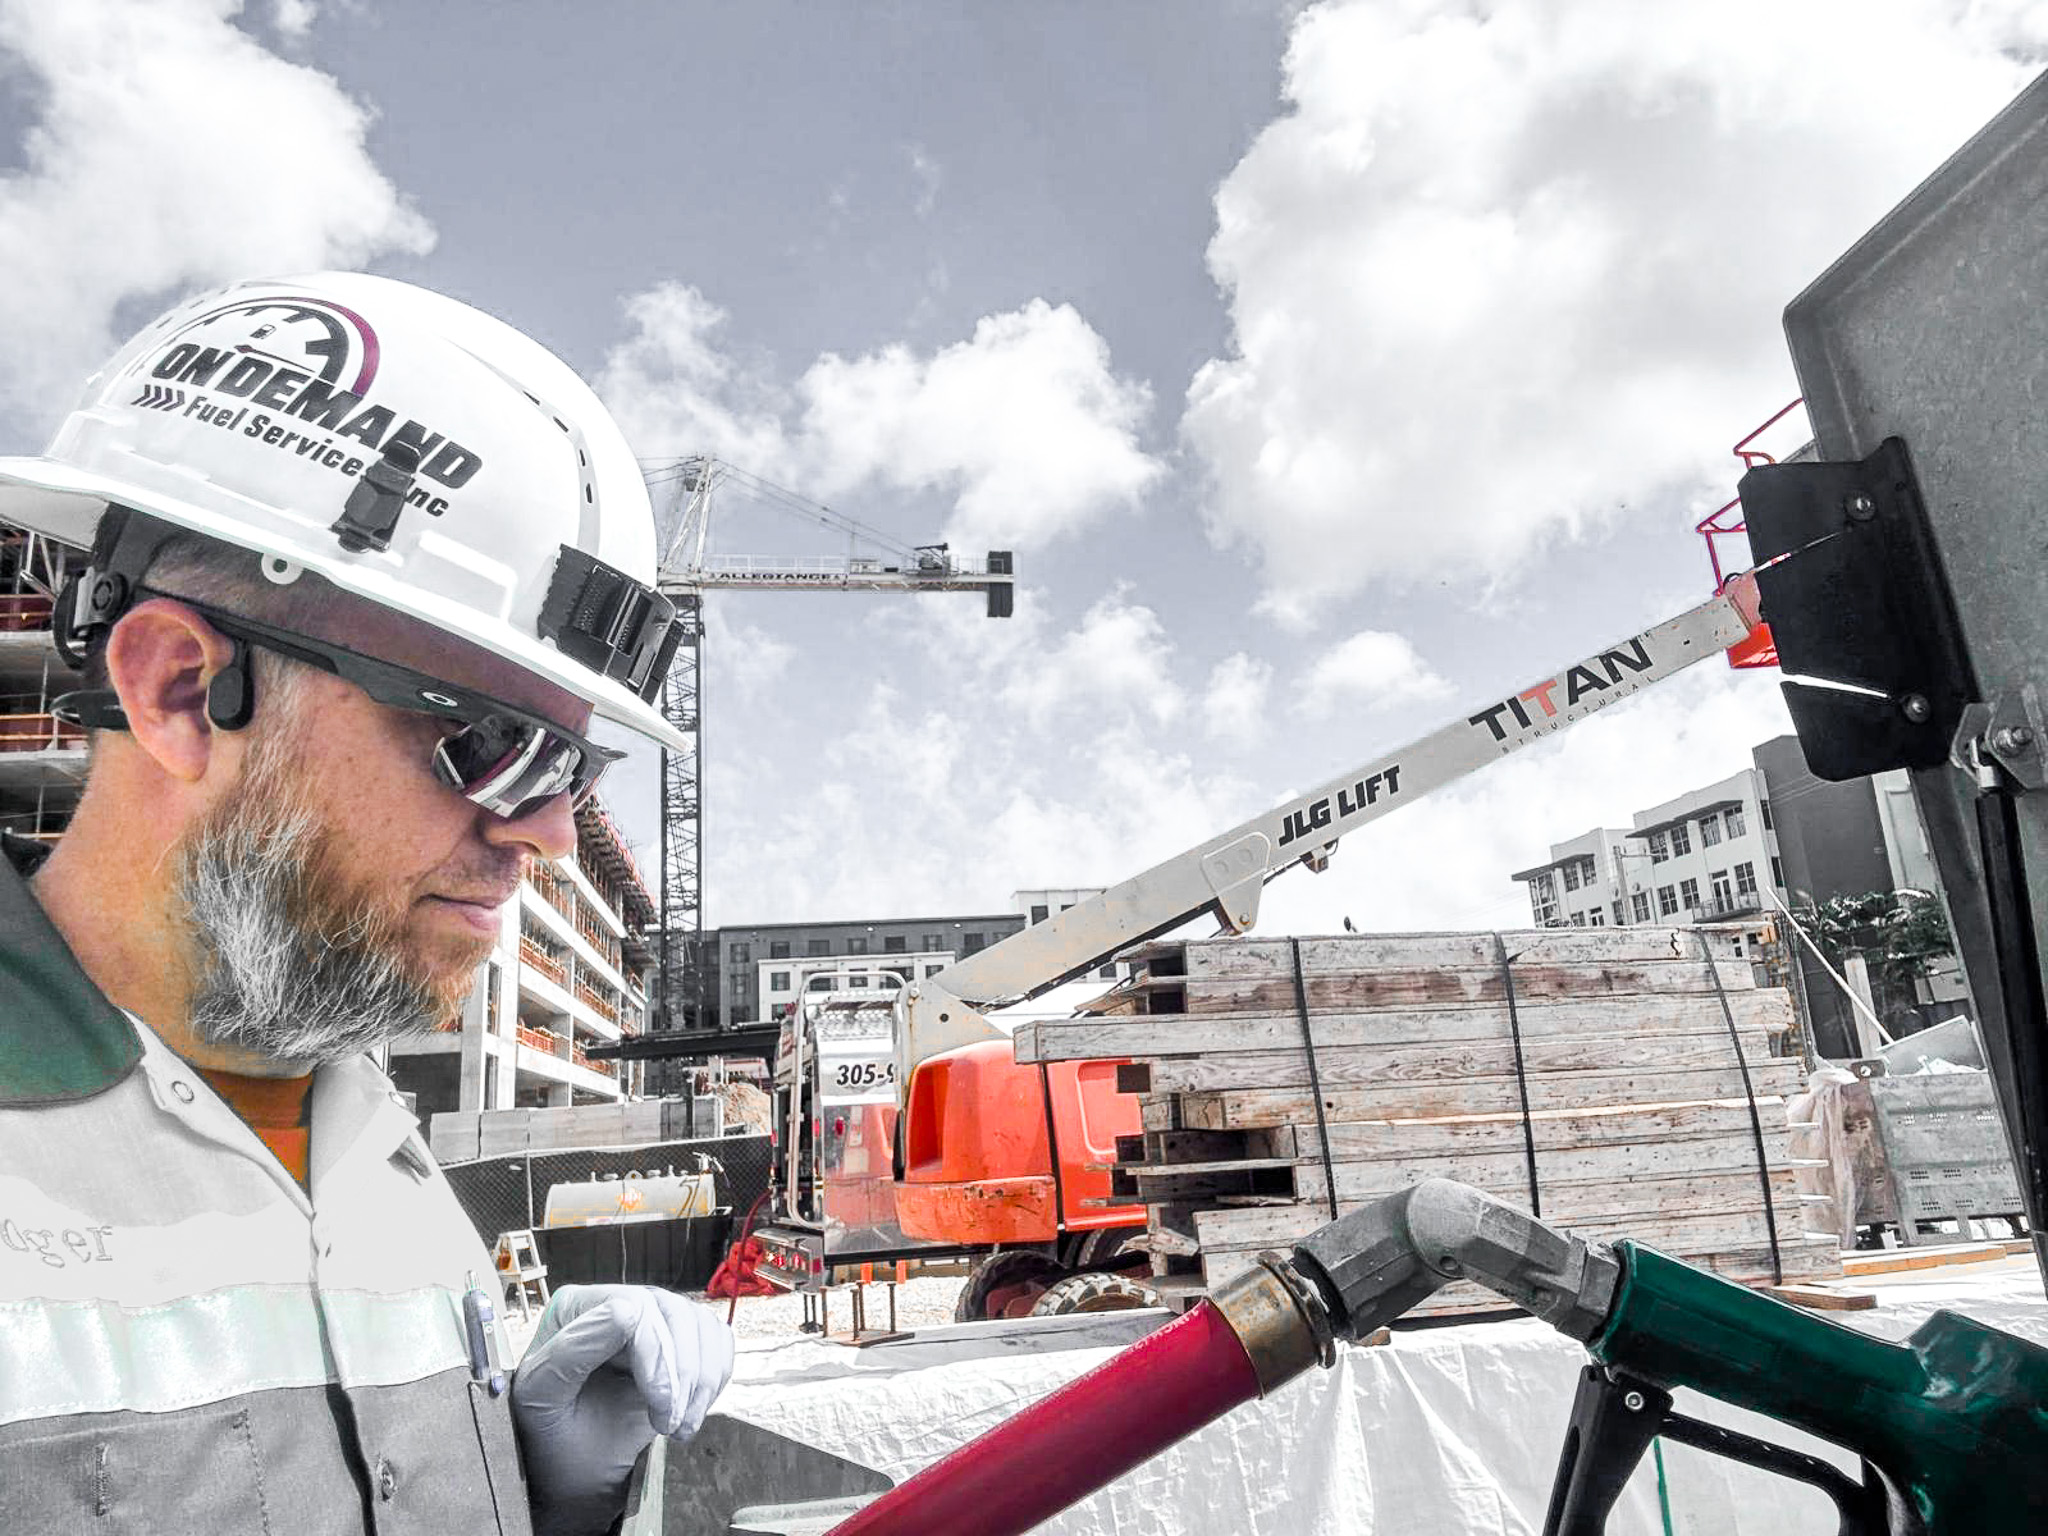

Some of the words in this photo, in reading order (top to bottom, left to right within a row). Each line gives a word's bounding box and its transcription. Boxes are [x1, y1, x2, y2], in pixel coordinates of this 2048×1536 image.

[152, 343, 236, 387] ON
[214, 356, 483, 489] DEMAND
[183, 396, 249, 431] Fuel
[405, 478, 449, 517] nc
[1468, 636, 1654, 742] TITAN
[1279, 798, 1332, 847] JLG
[1337, 765, 1400, 818] LIFT
